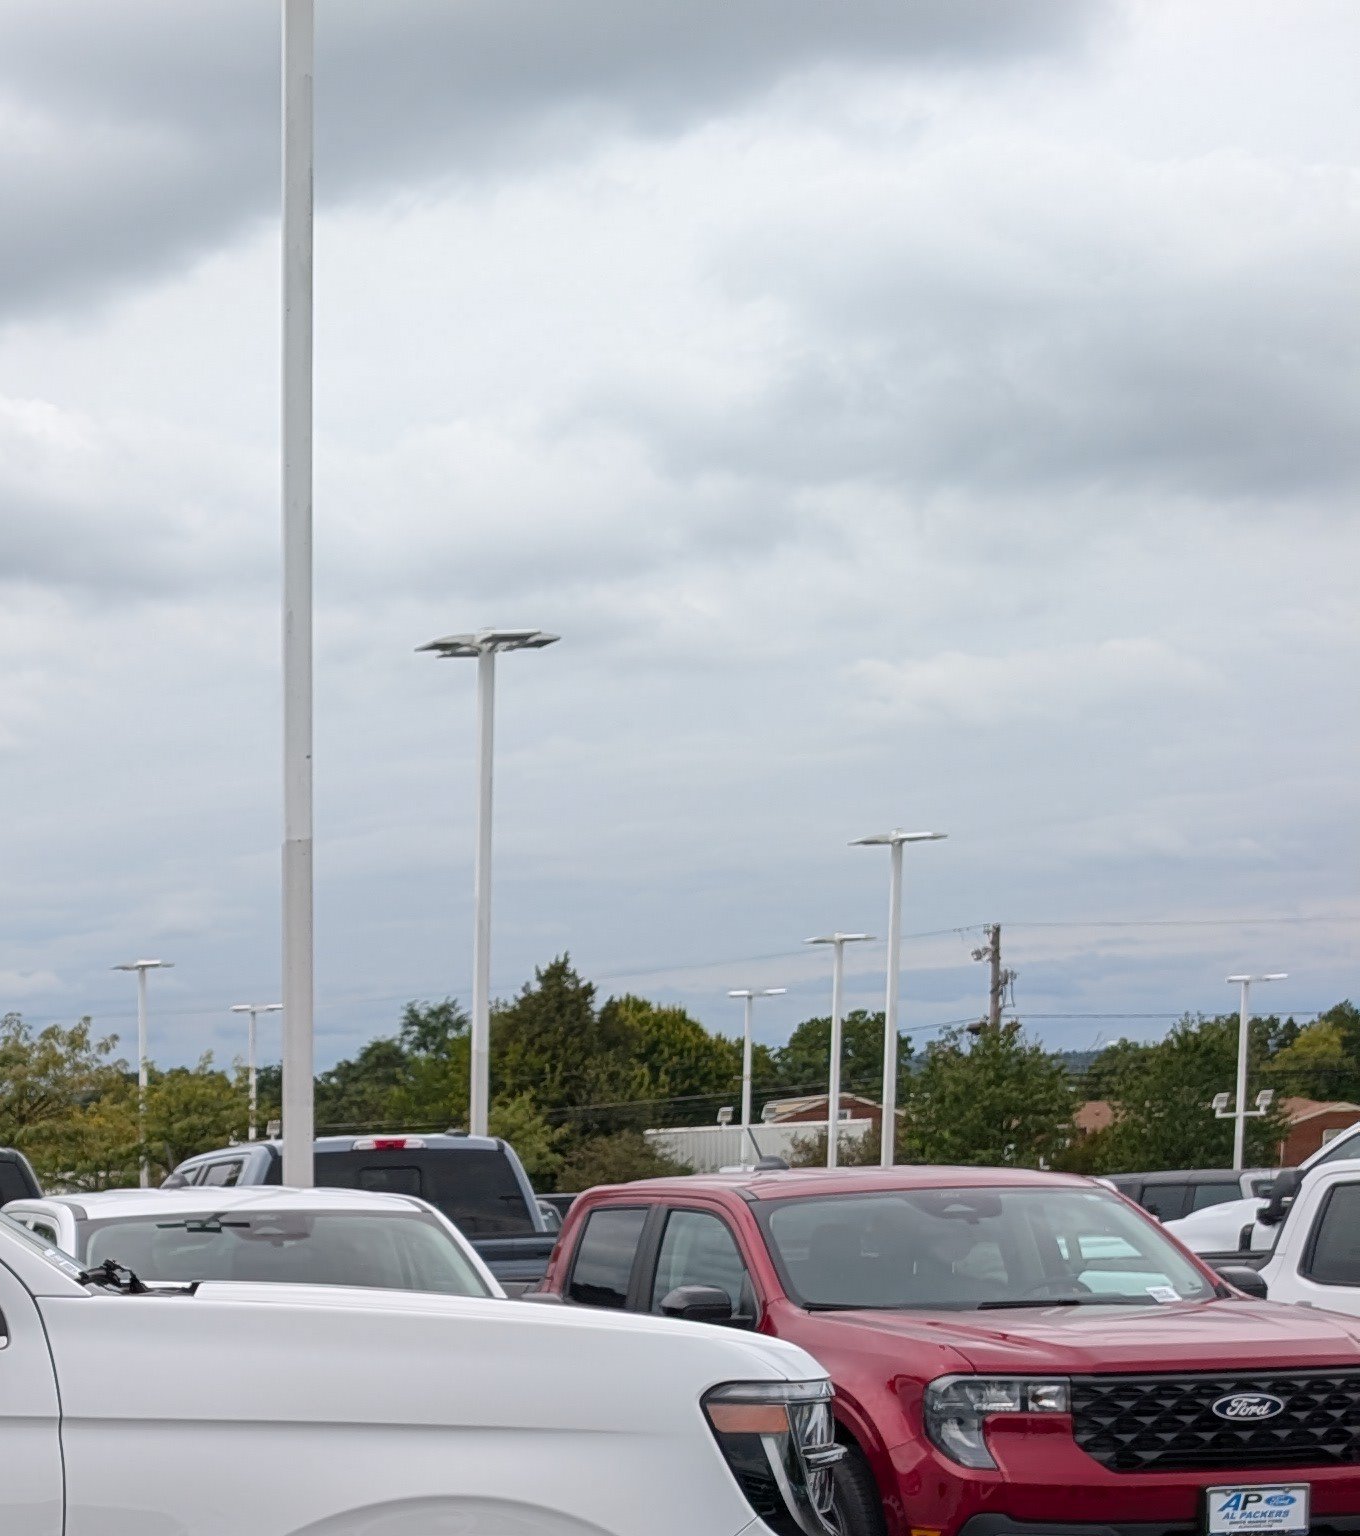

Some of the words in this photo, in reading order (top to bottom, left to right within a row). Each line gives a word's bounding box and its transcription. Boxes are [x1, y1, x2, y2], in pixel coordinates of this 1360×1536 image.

[1225, 1397, 1273, 1417] Ford
[1217, 1493, 1263, 1511] AP
[1222, 1511, 1236, 1520] AL
[1240, 1509, 1290, 1519] PACKERS
